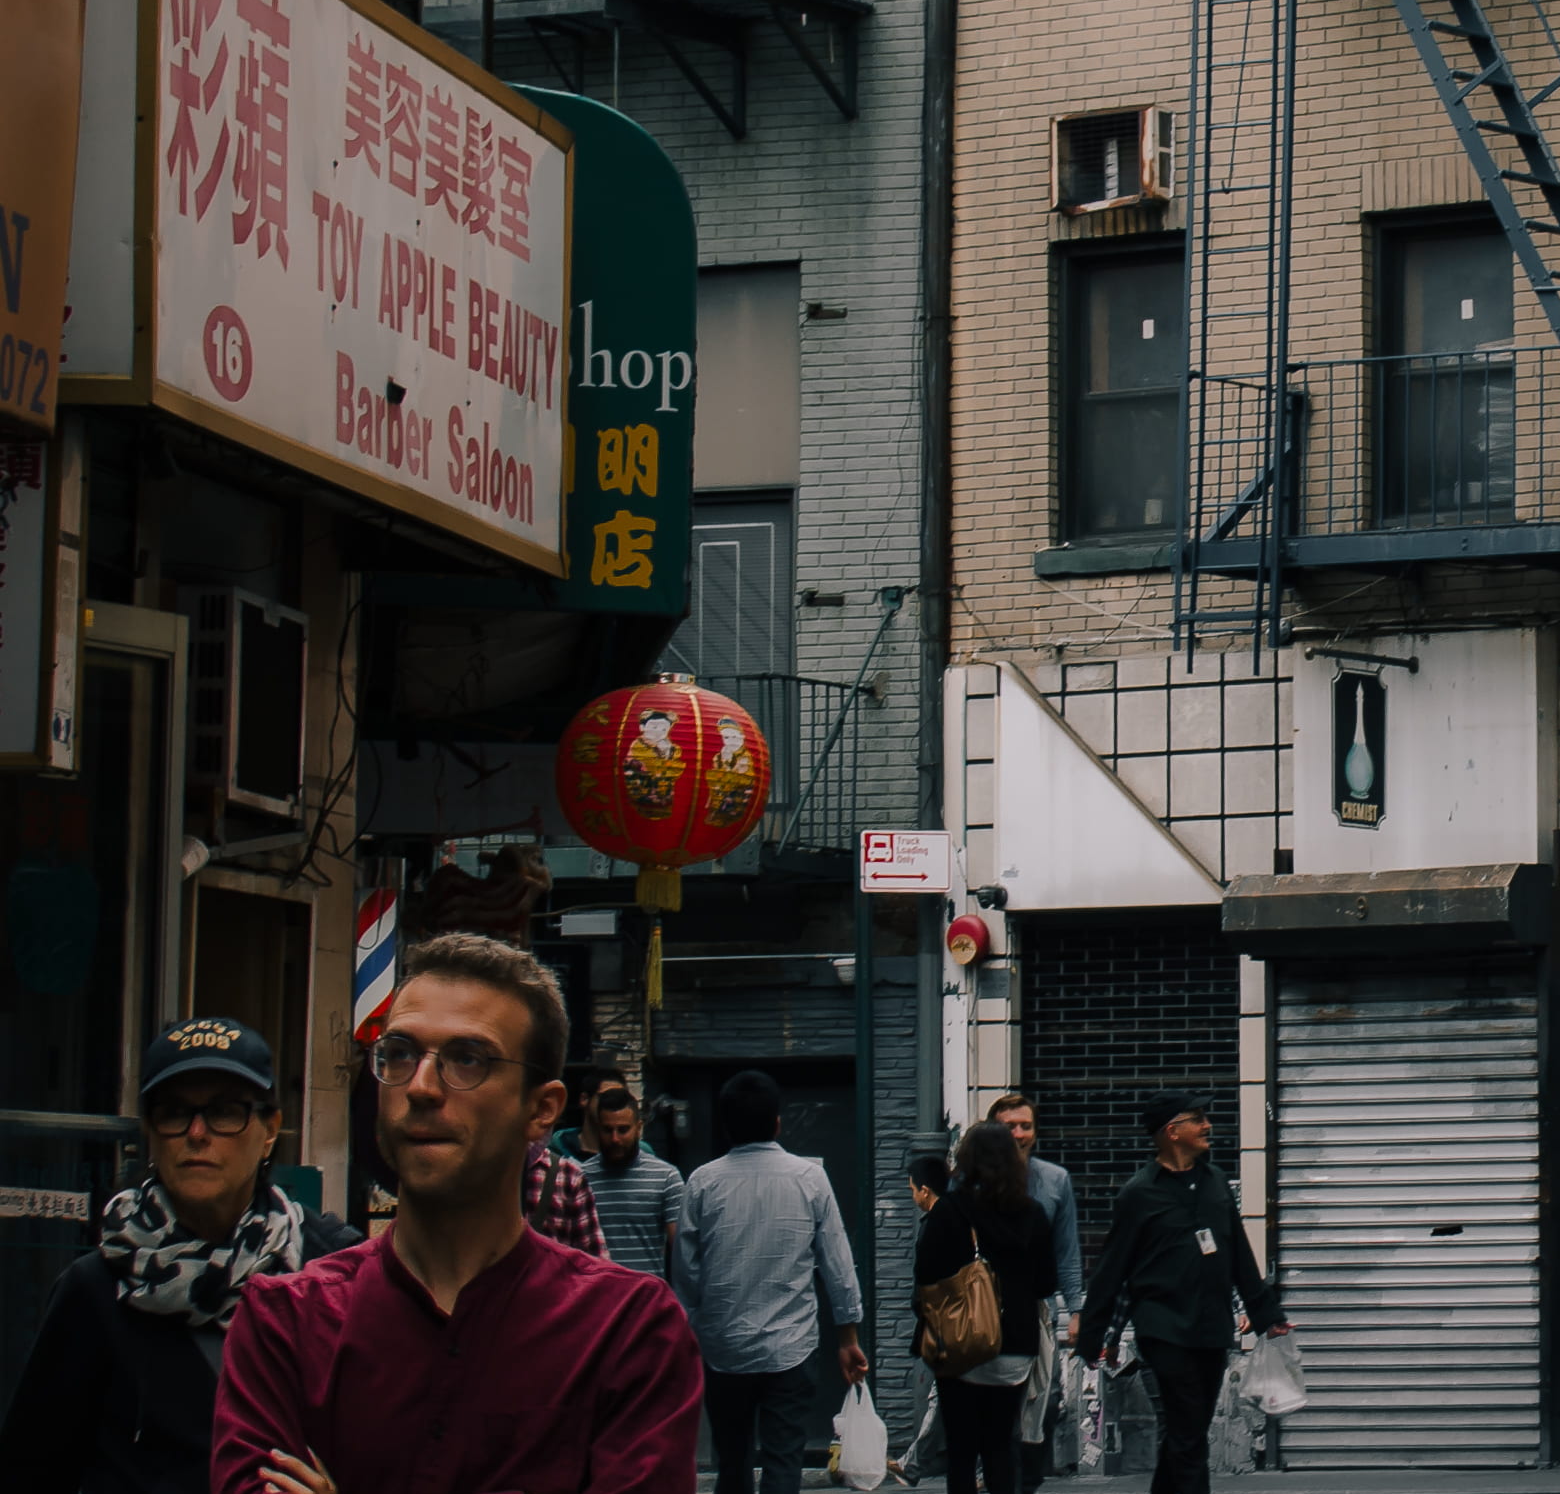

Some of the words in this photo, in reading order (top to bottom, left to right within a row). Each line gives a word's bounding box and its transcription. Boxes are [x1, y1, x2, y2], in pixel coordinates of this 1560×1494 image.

[344, 32, 533, 264] 美容美髮室
[312, 190, 364, 310] TOY
[378, 232, 457, 361] APPLE
[468, 279, 558, 411] BEAUTY
[212, 319, 243, 385] 16
[571, 299, 692, 412] hop
[336, 350, 432, 481] Barber
[447, 405, 534, 526] Saloon
[896, 846, 928, 856] Loading
[897, 835, 920, 845] Truck
[1341, 801, 1379, 822] CHEMIST
